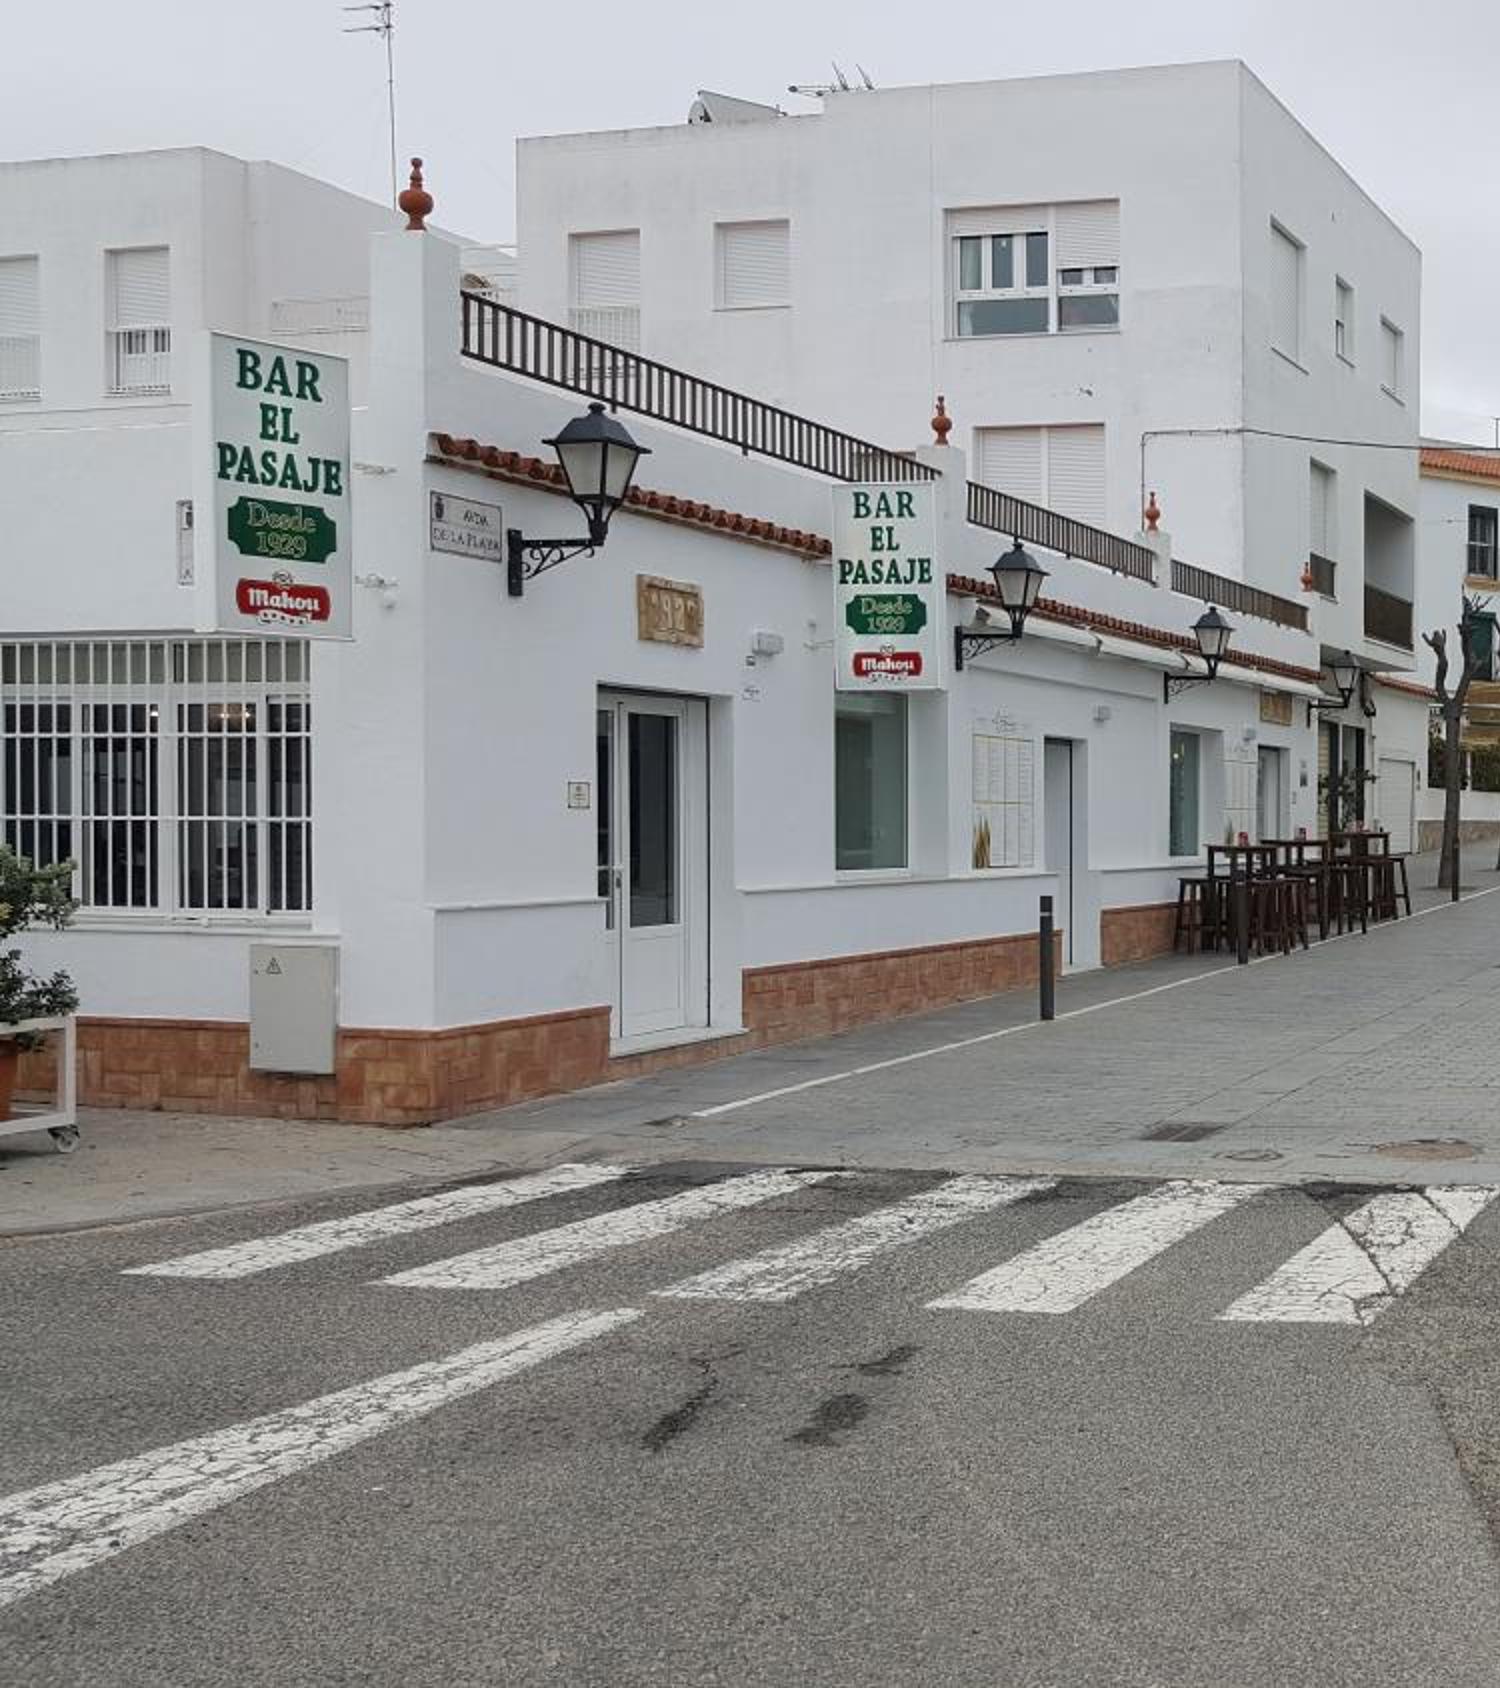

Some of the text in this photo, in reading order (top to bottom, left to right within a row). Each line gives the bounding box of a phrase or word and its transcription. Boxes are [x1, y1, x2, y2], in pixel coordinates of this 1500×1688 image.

[236, 348, 323, 402] BAR
[259, 402, 300, 445] EL
[216, 441, 343, 496] PASAJE
[247, 502, 318, 534] Desde
[852, 491, 916, 519] BAR
[255, 531, 308, 559] 1929
[870, 525, 900, 552] EL
[838, 558, 932, 585] PASAJE
[248, 586, 320, 612] Mahou
[860, 596, 913, 615] Desde
[861, 657, 915, 672] Mahou
